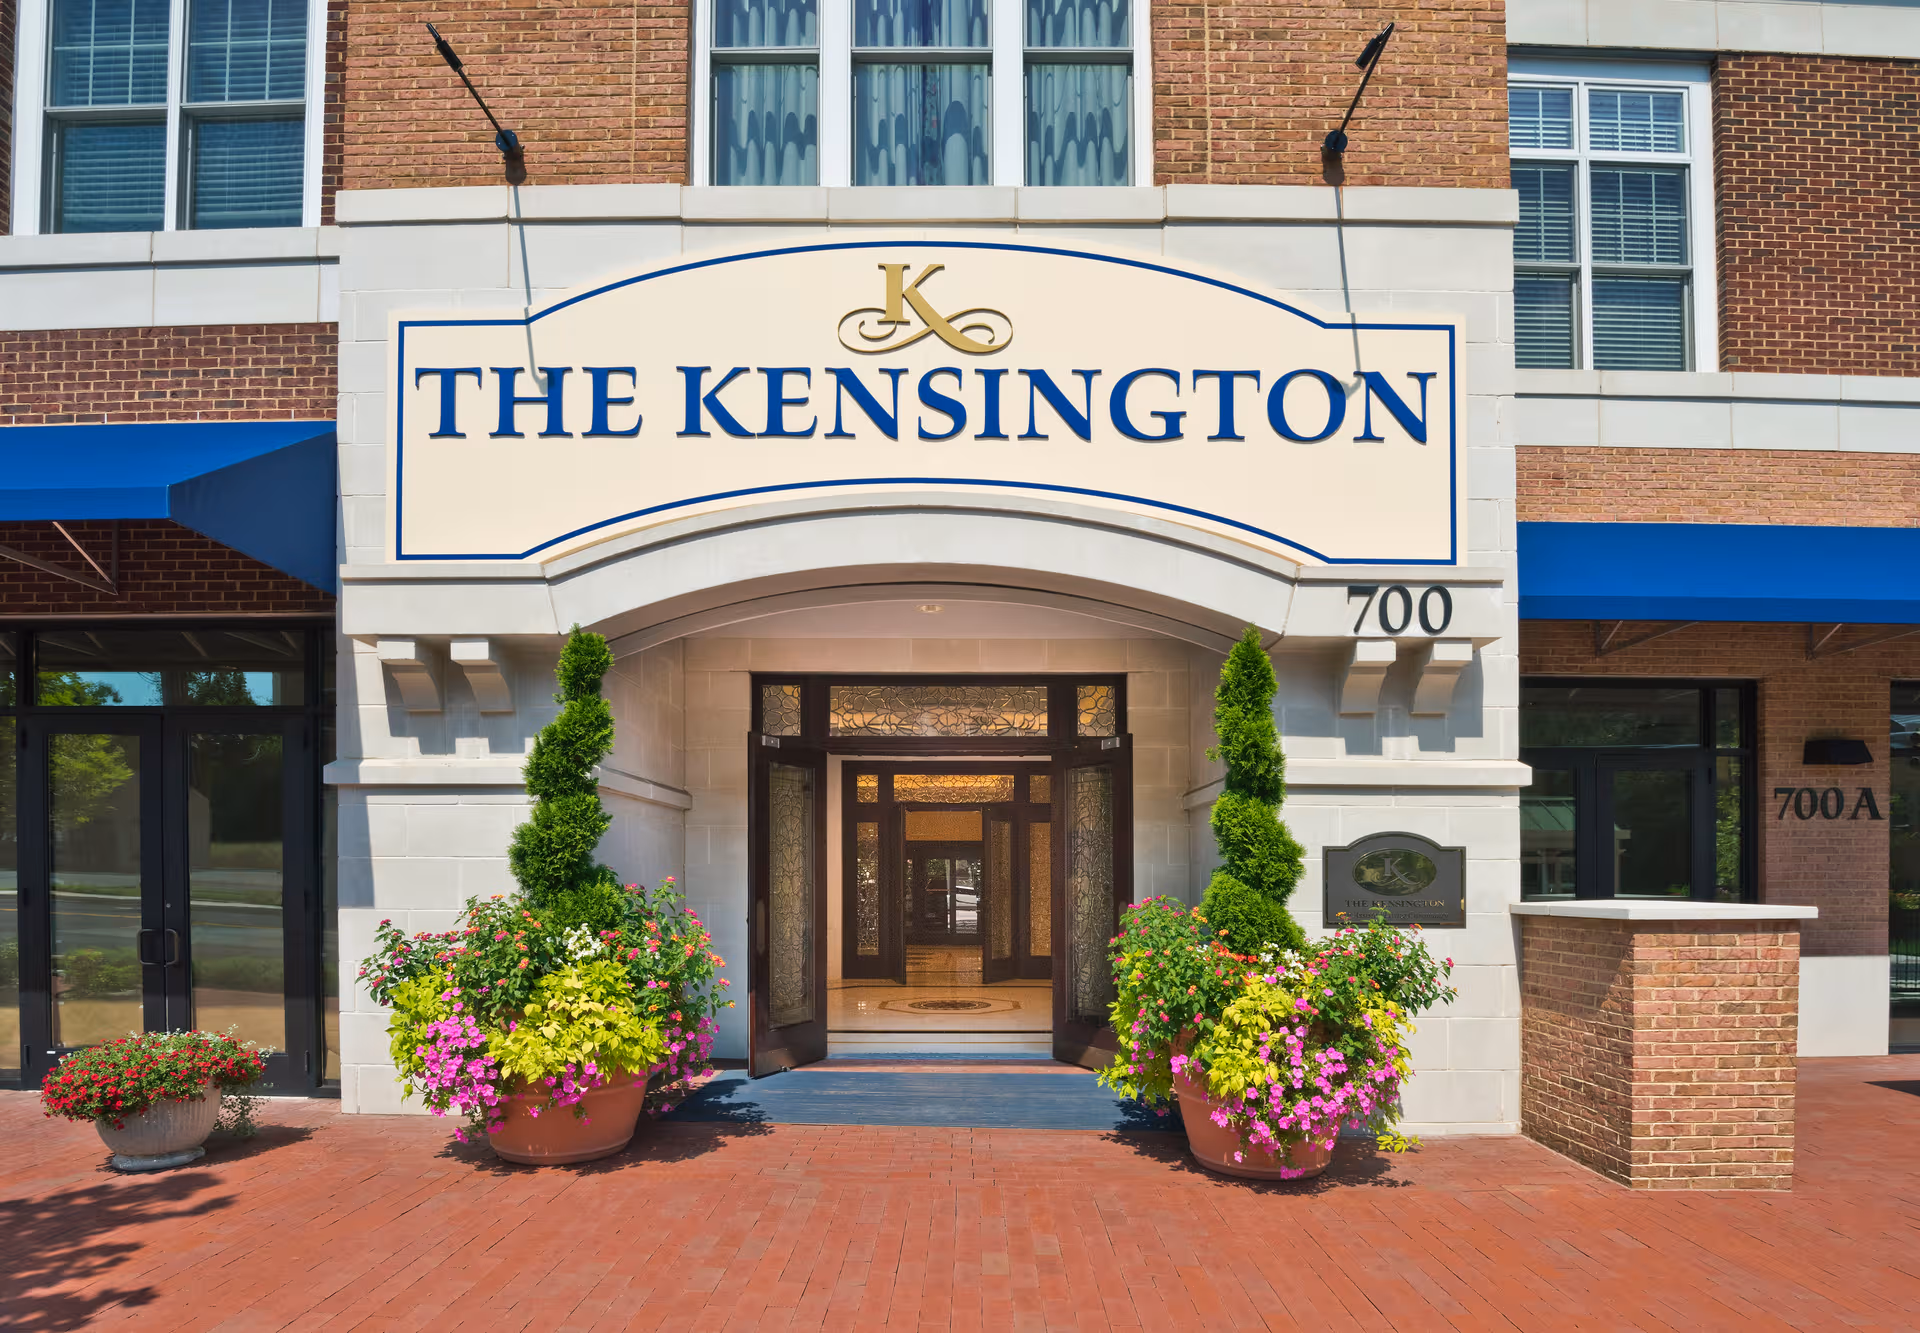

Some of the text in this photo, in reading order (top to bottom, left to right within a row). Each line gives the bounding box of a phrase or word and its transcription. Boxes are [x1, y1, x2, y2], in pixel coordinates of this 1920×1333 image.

[837, 262, 1014, 356] K
[415, 365, 1438, 444] THE KENSINGTON
[1347, 585, 1453, 636] 700
[1345, 899, 1445, 908] THE KENSINGTON
